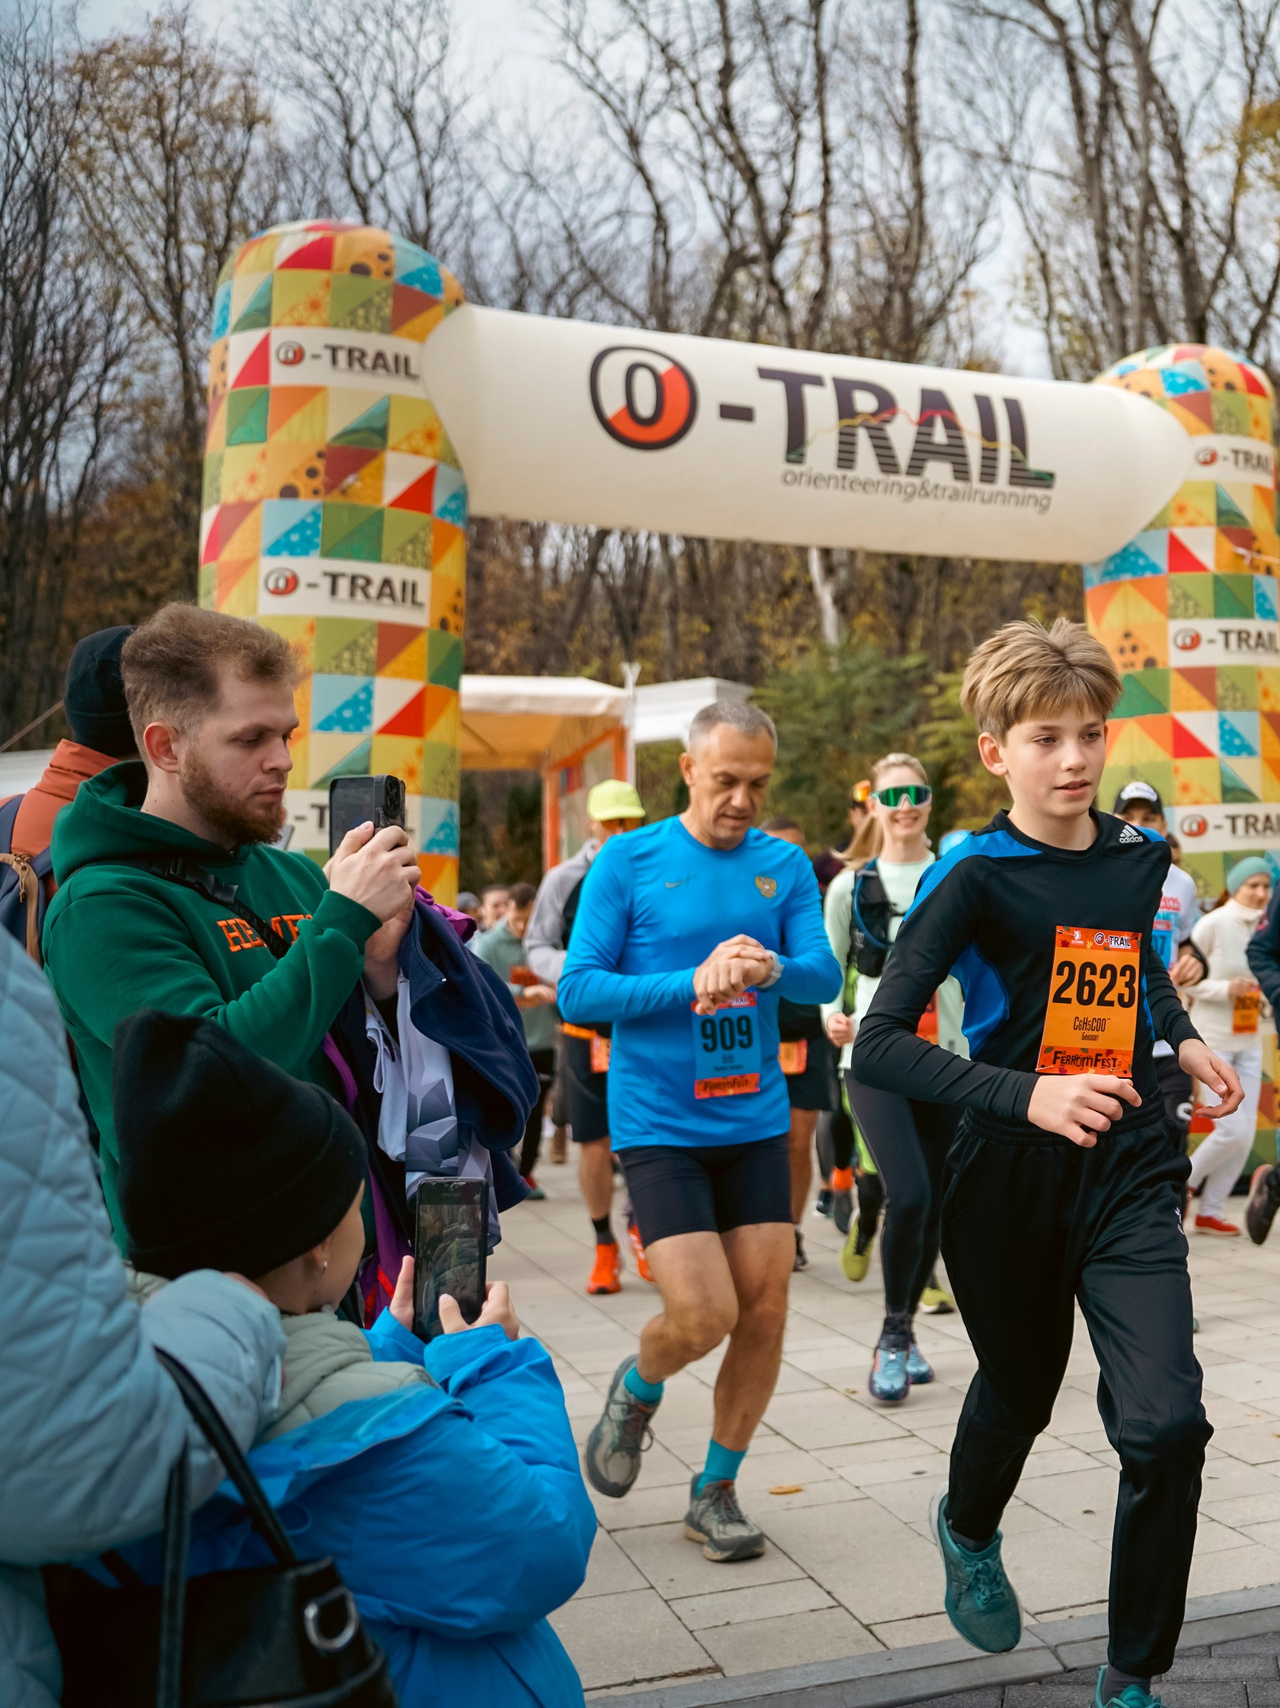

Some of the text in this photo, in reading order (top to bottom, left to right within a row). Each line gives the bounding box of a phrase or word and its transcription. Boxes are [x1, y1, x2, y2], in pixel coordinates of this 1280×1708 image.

[782, 467, 1052, 515] orienteering&trailrunning
[1119, 834, 1144, 844] adidas
[1052, 960, 1136, 1009] 2623
[701, 1015, 753, 1053] 909
